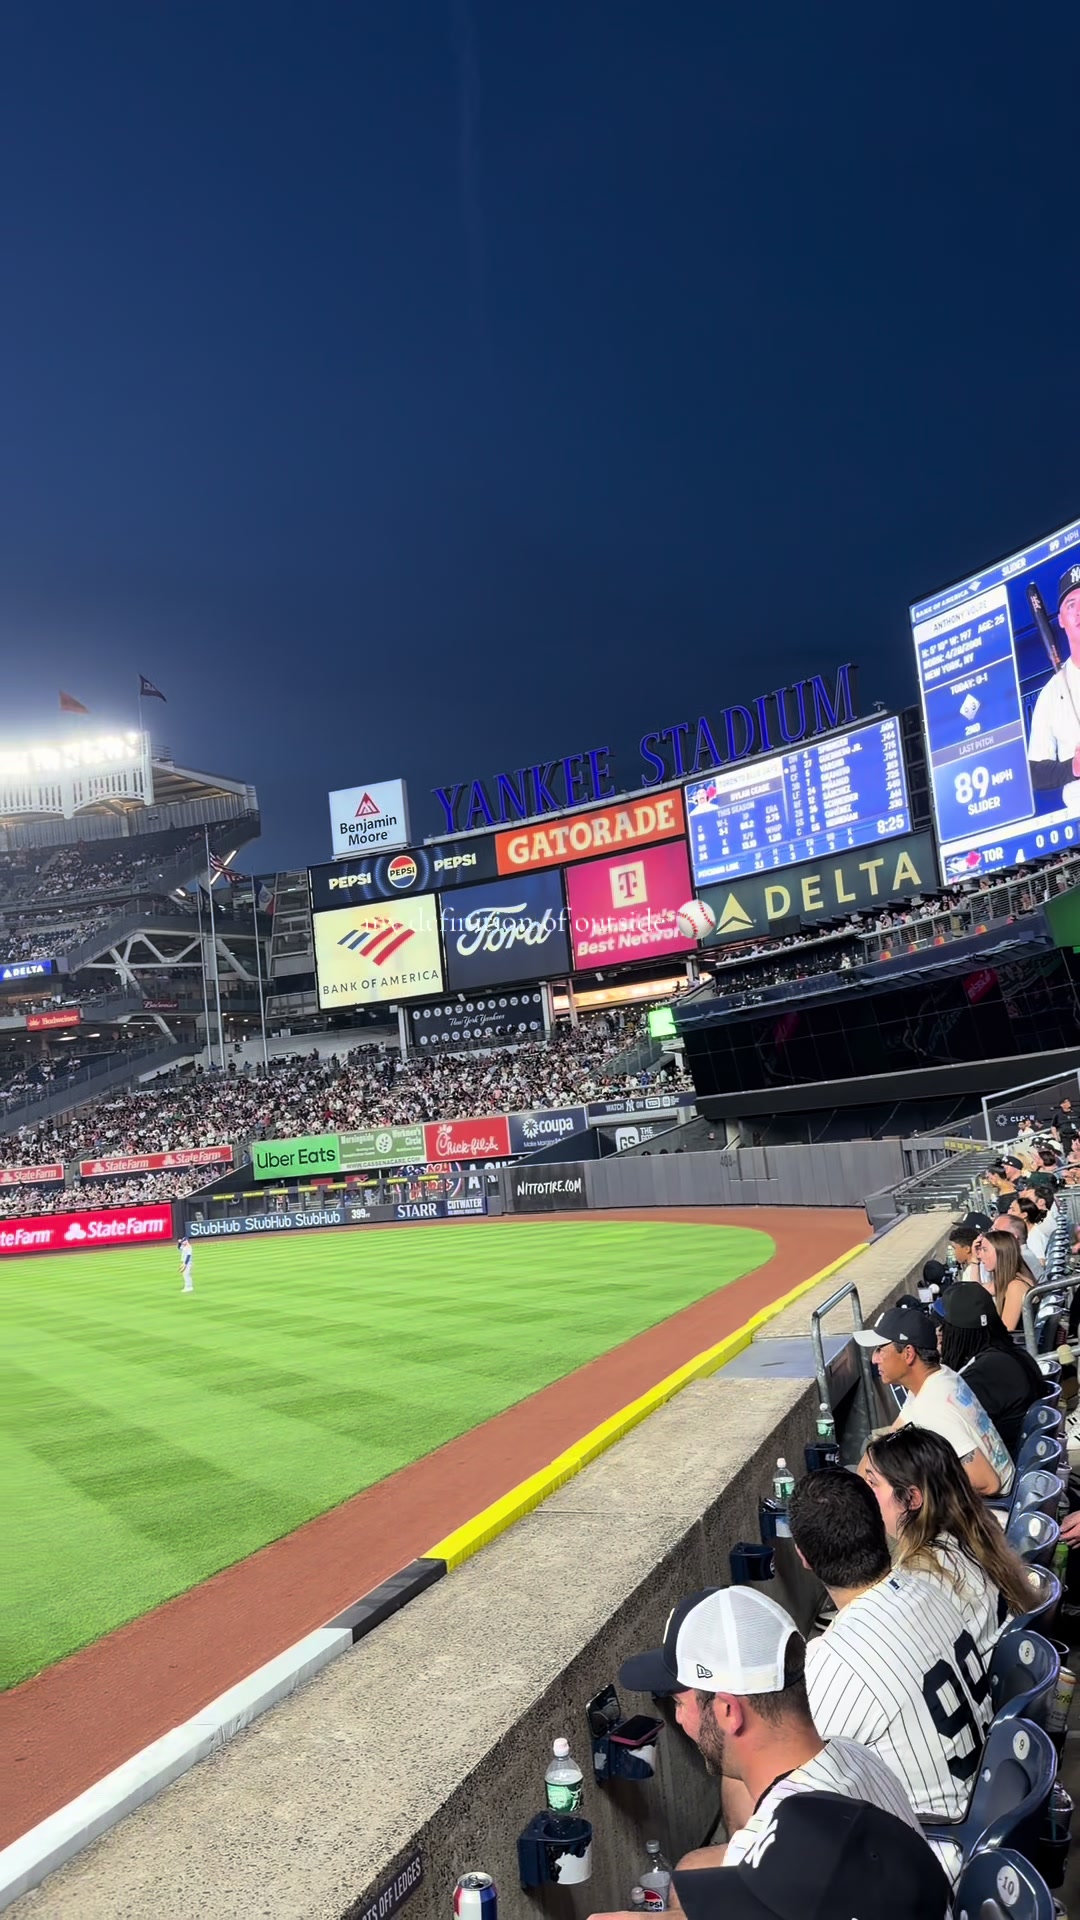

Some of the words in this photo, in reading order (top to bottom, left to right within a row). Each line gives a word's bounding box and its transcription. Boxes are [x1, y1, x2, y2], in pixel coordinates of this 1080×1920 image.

[1064, 529, 1079, 544] MPH
[933, 610, 965, 631] ANTHONY
[978, 619, 994, 634] AGE:
[924, 667, 941, 681] NEW
[963, 652, 974, 665] NY
[950, 677, 975, 695] TODAY:
[431, 746, 615, 835] YANKEE
[639, 662, 858, 788] STADIUM
[959, 742, 974, 756] LAST
[975, 736, 994, 752] PITCH
[954, 766, 990, 804] 89
[991, 768, 1013, 786] MPH
[731, 801, 755, 814] SEASON
[765, 805, 778, 814] ERA
[967, 795, 1001, 816] SLIDER
[340, 814, 397, 835] Benjamin
[507, 798, 676, 865] GATORADE
[877, 814, 905, 834] 8:25
[348, 831, 388, 847] Moore
[982, 847, 1004, 864] TOR
[1015, 848, 1025, 864] 4
[1036, 834, 1045, 848] 0
[1050, 830, 1059, 844] 0
[1064, 825, 1074, 840] 0
[328, 872, 372, 890] PEPSI
[389, 866, 416, 878] PEPSI
[433, 853, 477, 872] PEPSI
[618, 870, 637, 899] T
[764, 851, 922, 920] DELTA
[456, 902, 553, 956] Ford
[577, 936, 615, 957] Best
[617, 927, 685, 949] Networ
[13, 964, 45, 977] DELTA
[323, 981, 358, 995] BANK
[361, 979, 376, 990] OF
[380, 969, 440, 987] AMERICA
[41, 1013, 79, 1026] Budweiser
[449, 1017, 462, 1027] New
[462, 1015, 480, 1028] York
[480, 1012, 505, 1026] Yankees
[605, 1103, 624, 1112] WATCH
[635, 1101, 644, 1109] ON
[538, 1117, 575, 1136] coupa
[640, 1126, 653, 1134] THE
[341, 1133, 375, 1145] Morningside
[405, 1136, 422, 1146] Circle
[436, 1131, 498, 1156] Chick-fil-A
[256, 1152, 295, 1169] Uber
[298, 1148, 336, 1165] Eats
[517, 1178, 582, 1197] NITTOTIRE.COM
[351, 1208, 366, 1219] 399
[397, 1202, 437, 1218] STARR
[447, 1198, 482, 1210] CUTWATER
[190, 1219, 240, 1236] StubHub
[245, 1215, 292, 1231] StubHub
[295, 1211, 341, 1227] StubHub
[1018, 1739, 1025, 1751] 9
[378, 1889, 393, 1918] OFF
[393, 1856, 422, 1901] LEDGES
[1000, 1877, 1015, 1895] 10
